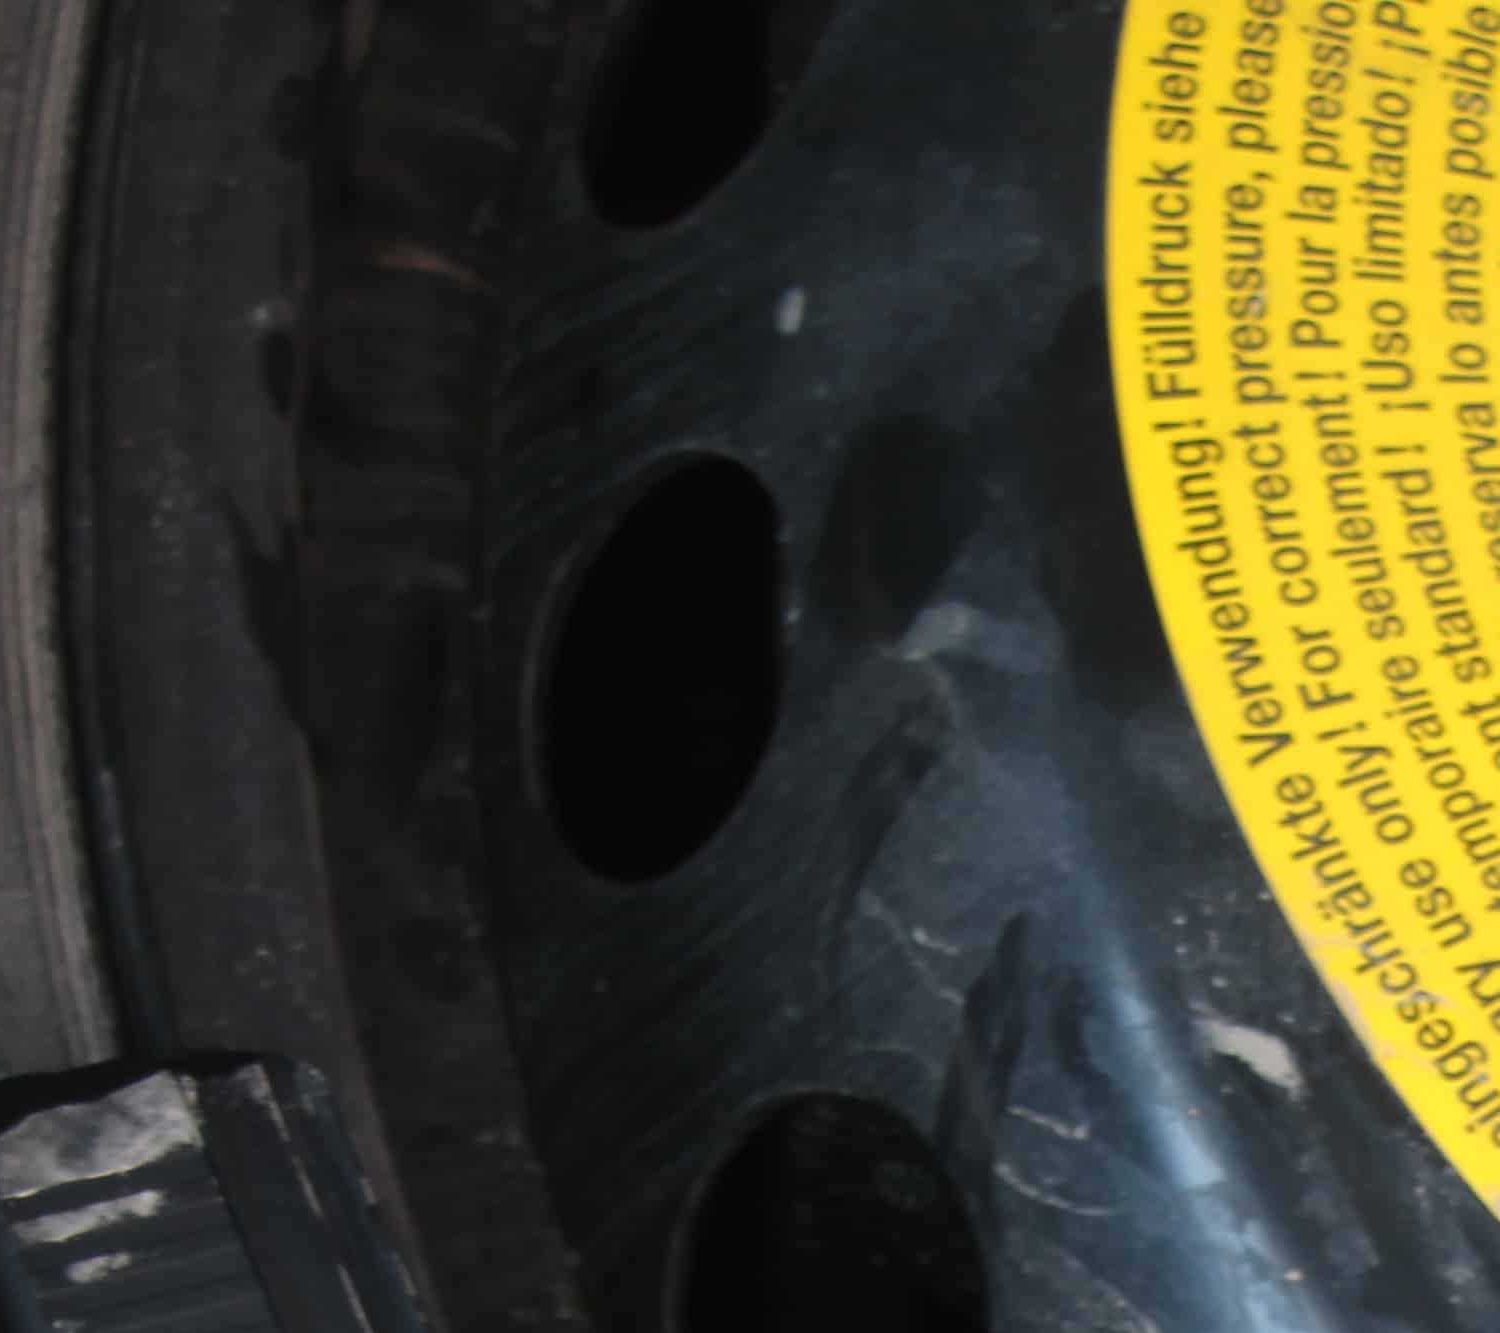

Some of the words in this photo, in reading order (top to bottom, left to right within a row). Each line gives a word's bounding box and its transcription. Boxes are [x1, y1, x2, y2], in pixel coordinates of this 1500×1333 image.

[1142, 9, 1207, 143] siehe
[1213, 0, 1281, 154] please
[1283, 183, 1338, 224] la
[1344, 66, 1416, 282] limitado!
[1137, 161, 1201, 401] Fülldruck
[1223, 169, 1289, 405] pressure,
[1288, 236, 1342, 349] Pour
[1431, 191, 1484, 326] antes
[1437, 340, 1490, 384] lo
[1230, 420, 1319, 607] correct
[1151, 417, 1295, 768] Verwendung!
[1290, 624, 1355, 712] For
[1315, 720, 1415, 845] only!
[1398, 857, 1473, 949] use
